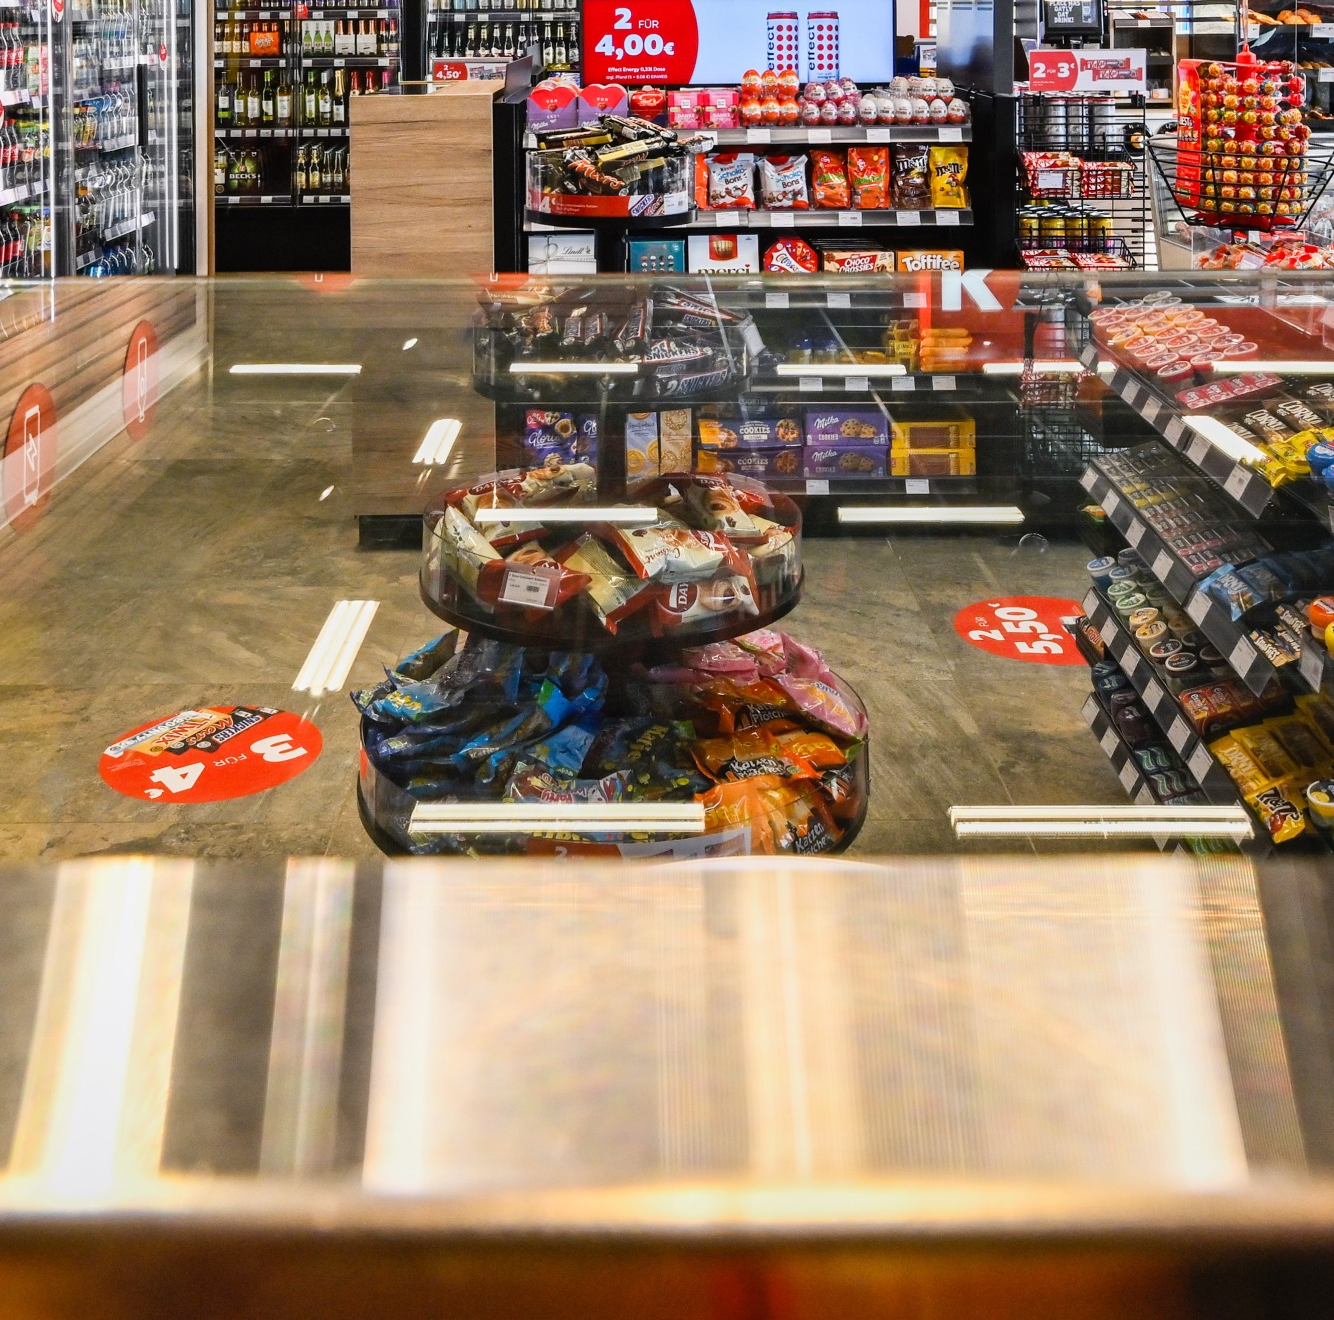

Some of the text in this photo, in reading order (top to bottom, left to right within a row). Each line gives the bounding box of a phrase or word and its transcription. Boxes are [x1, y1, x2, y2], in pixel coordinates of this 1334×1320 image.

[613, 7, 659, 29] 2 FÜR
[595, 34, 675, 60] 4,00€
[1033, 62, 1047, 79] 2
[569, 158, 625, 190] Mars
[724, 175, 742, 186] Bons
[781, 177, 800, 189] Bons
[632, 193, 655, 217] SNICKERS
[563, 247, 584, 257] Lindt
[844, 255, 871, 267] CHOCO
[901, 253, 960, 272] Toffifee
[813, 415, 840, 430] Milka
[739, 426, 771, 436] COOKIES
[818, 433, 839, 441] COOKIES
[737, 457, 769, 466] COOKIES
[811, 448, 838, 462] Milka
[967, 628, 1005, 641] 2
[152, 718, 211, 745] TWIX
[211, 714, 263, 744] SNICKERS
[250, 733, 308, 763] 3
[213, 753, 248, 768] FÜR
[794, 821, 826, 852] Katzen
